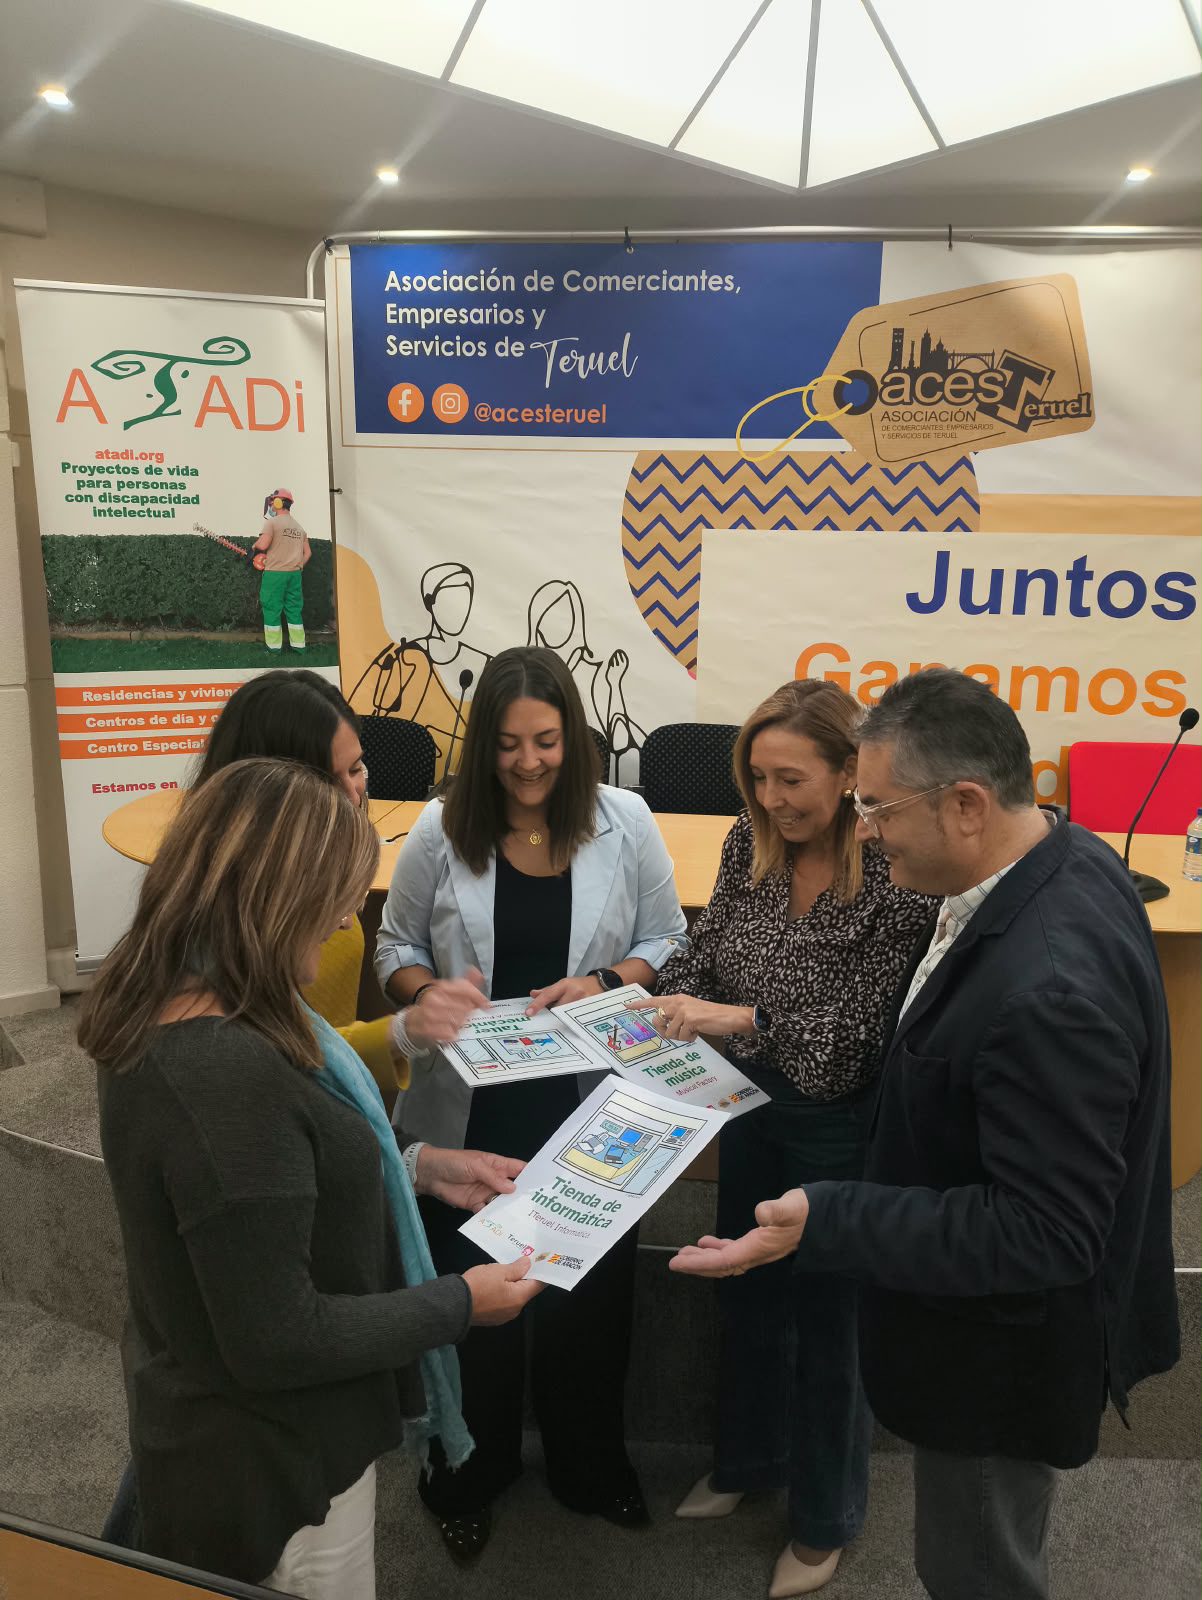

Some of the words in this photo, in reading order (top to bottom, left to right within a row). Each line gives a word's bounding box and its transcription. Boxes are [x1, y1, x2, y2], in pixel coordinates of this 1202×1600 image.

[384, 267, 516, 293] Asociación
[523, 269, 555, 292] de
[562, 270, 742, 294] Comerciantes,
[385, 303, 525, 329] Empresarios
[532, 306, 547, 330] y
[386, 334, 488, 357] Servicios
[494, 336, 525, 358] de
[529, 332, 639, 389] Teruel
[474, 402, 607, 425] @acesteruel
[881, 408, 977, 422] ASOCIACIÓN
[881, 424, 891, 432] DE
[933, 431, 959, 439] TERUEL
[95, 449, 164, 463] atadi.org
[61, 462, 140, 477] Proyectos
[144, 464, 163, 477] de
[167, 465, 199, 477] vida
[76, 478, 112, 490] para
[116, 479, 187, 491] personas
[64, 492, 94, 504] con
[98, 492, 200, 506] discapacidad
[92, 506, 176, 519] intelectual
[905, 550, 1197, 621] Juntos
[82, 689, 174, 703] Residencias
[177, 690, 187, 701] y
[191, 687, 239, 698] vivien
[86, 716, 144, 728] Centros
[149, 714, 167, 725] de
[172, 713, 194, 724] día
[198, 715, 207, 726] y
[87, 742, 138, 754] Centro
[143, 738, 205, 752] Especial
[92, 782, 156, 794] Estamos
[160, 781, 178, 790] en
[642, 1057, 686, 1078] Tienda
[685, 1051, 702, 1062] de
[664, 1065, 707, 1087] música
[551, 1176, 599, 1208] Tienda
[603, 1198, 623, 1213] de
[530, 1187, 613, 1229] informática
